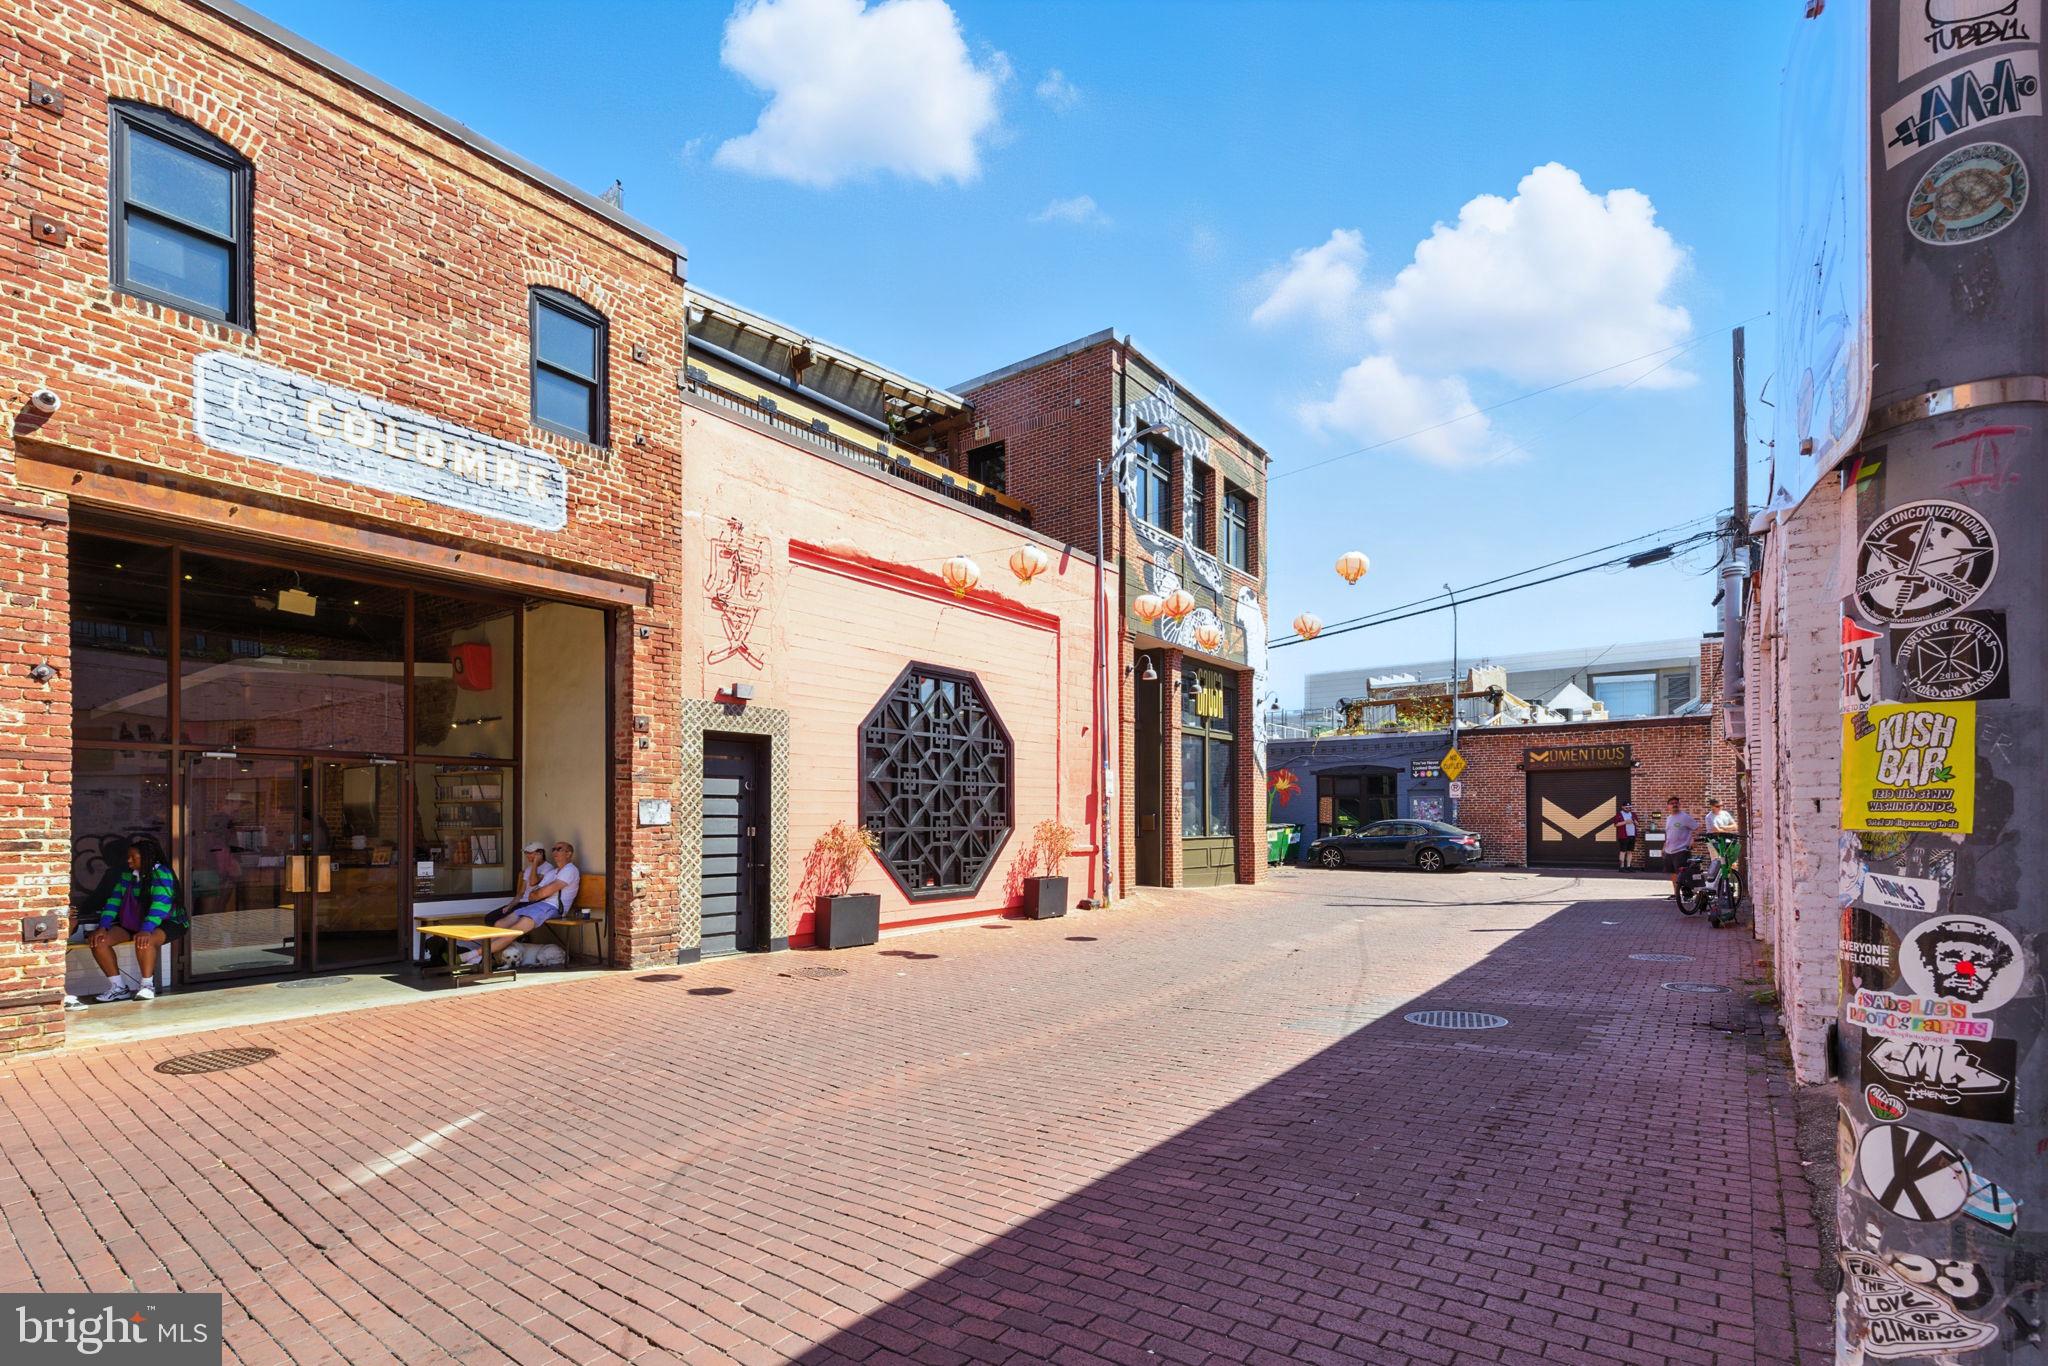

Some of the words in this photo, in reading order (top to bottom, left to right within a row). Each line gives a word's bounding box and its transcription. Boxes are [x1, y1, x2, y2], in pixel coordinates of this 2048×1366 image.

[305, 397, 551, 499] COLOMBE
[1872, 521, 1892, 539] THE
[1891, 505, 1989, 544] UNCONVENTIONAL
[1876, 711, 1957, 752] KUSH
[1876, 747, 1949, 787] BAR
[1868, 802, 1935, 812] WASHINGTON
[1848, 1259, 1881, 1277] FOR
[1860, 1278, 1886, 1291] THE
[1866, 1292, 1933, 1312] LOVE
[1911, 1313, 1939, 1325] OF
[1871, 1321, 1968, 1344] CLIMBING
